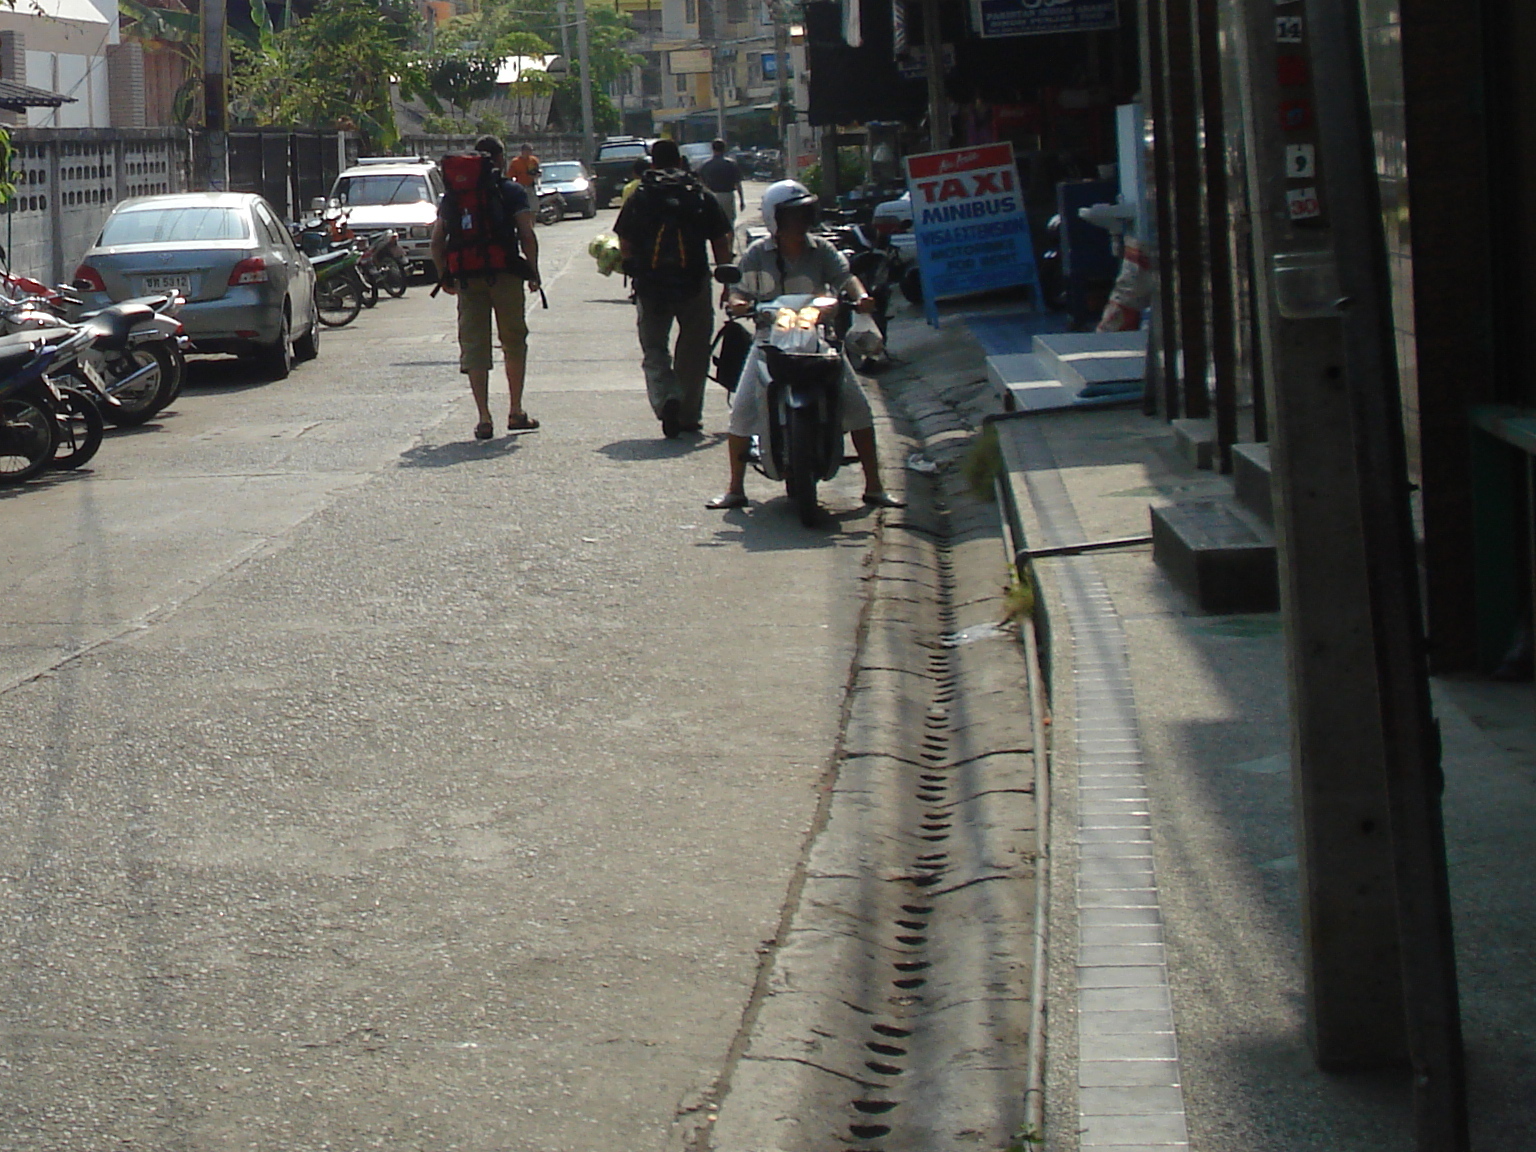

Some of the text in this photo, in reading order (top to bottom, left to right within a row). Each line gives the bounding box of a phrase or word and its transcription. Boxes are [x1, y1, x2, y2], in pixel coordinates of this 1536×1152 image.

[1278, 23, 1300, 38] 14
[1294, 155, 1308, 172] 9
[917, 170, 1015, 204] TAXI
[922, 196, 1017, 226] MINIBUS
[921, 217, 1025, 247] VISA EXTENSION
